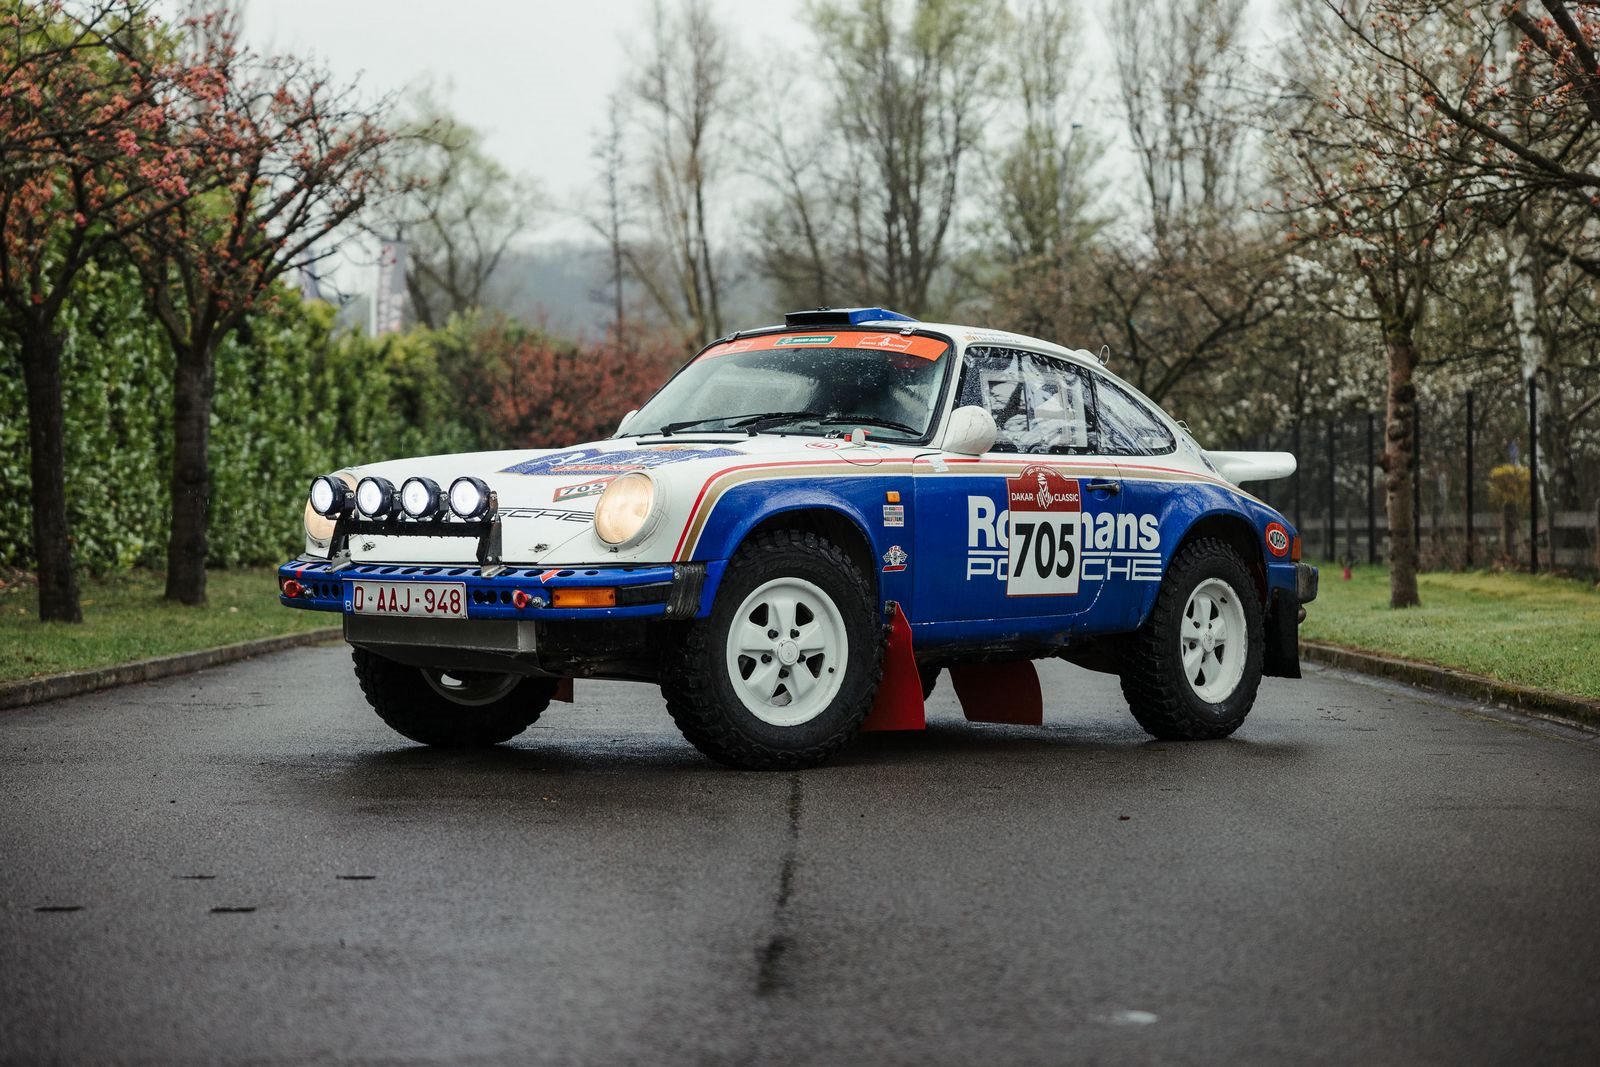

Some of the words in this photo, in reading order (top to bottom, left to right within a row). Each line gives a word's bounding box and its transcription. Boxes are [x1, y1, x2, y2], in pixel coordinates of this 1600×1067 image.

[563, 483, 604, 496] 705
[1011, 492, 1034, 501] DAKAR
[1054, 493, 1079, 502] CLASSIC
[1013, 521, 1075, 579] 705
